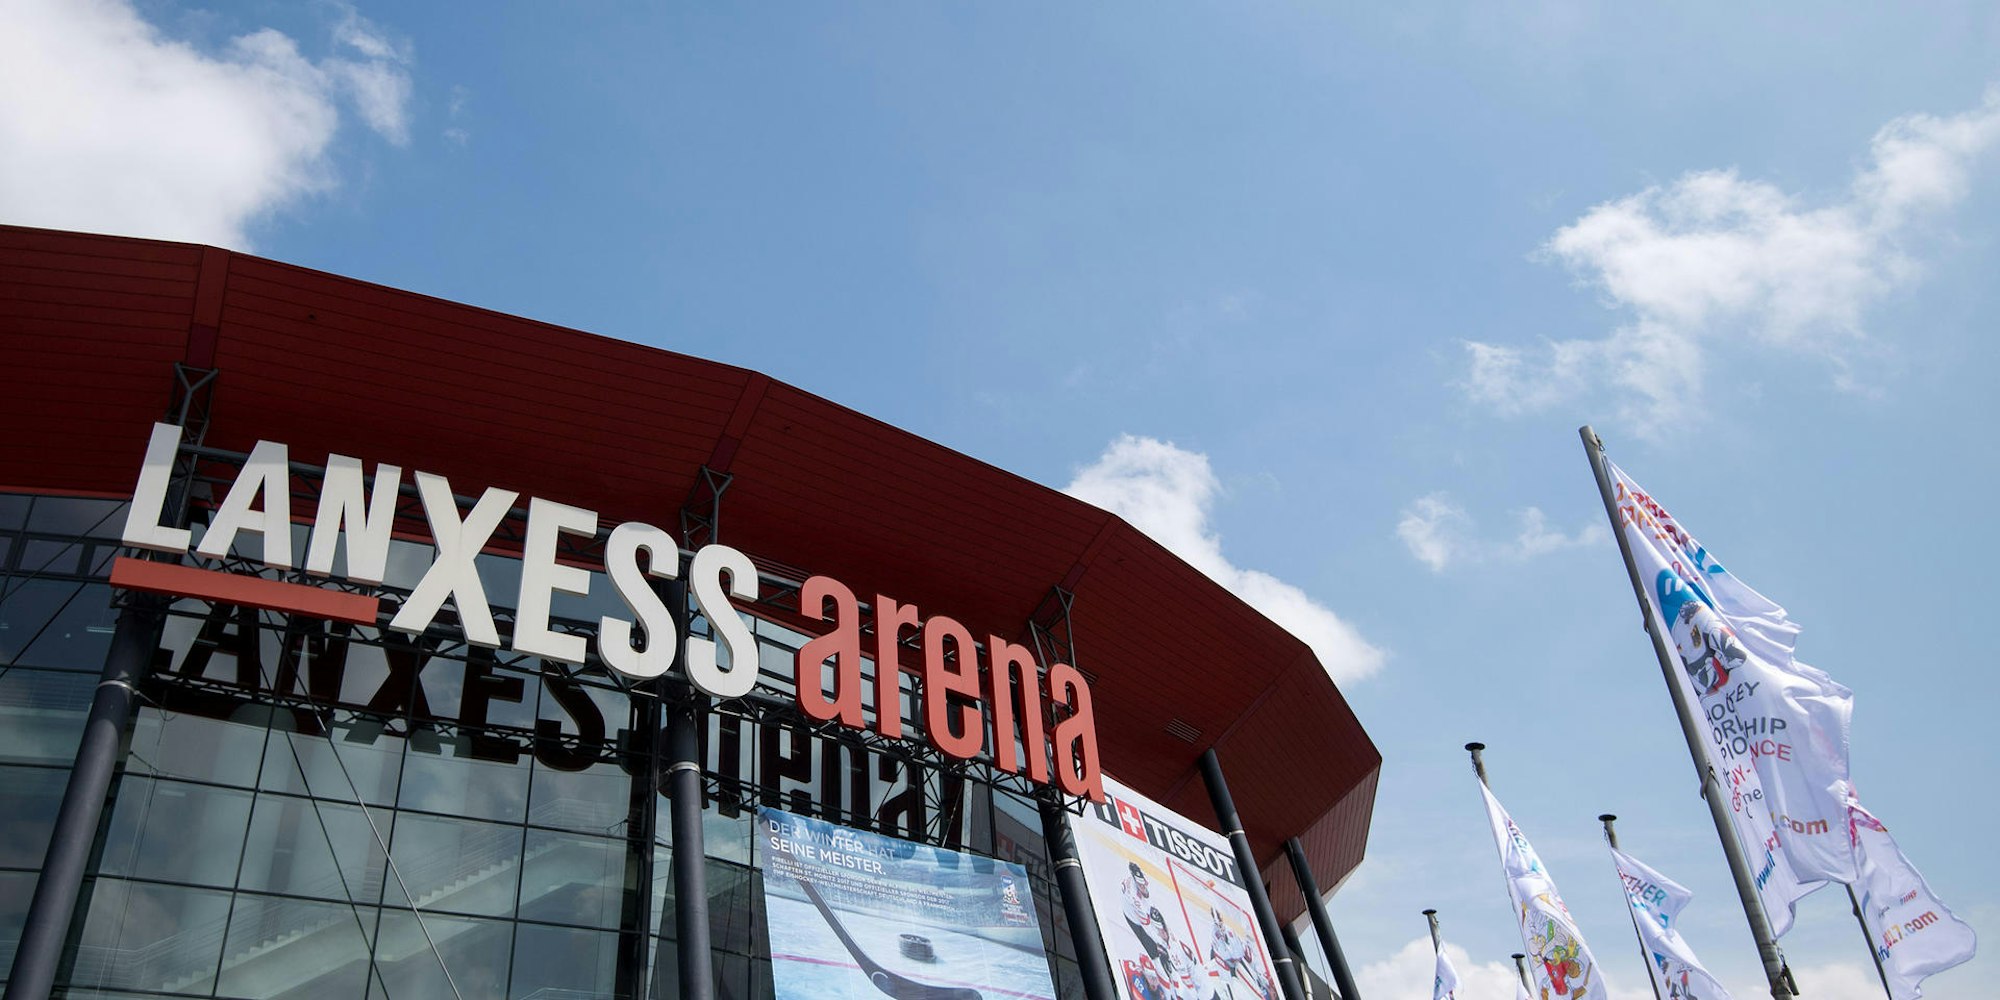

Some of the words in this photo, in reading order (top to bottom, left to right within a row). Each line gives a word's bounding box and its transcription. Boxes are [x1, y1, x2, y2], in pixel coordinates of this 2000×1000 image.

[122, 421, 759, 698] LANXESS
[796, 575, 1106, 805] arena
[1744, 716, 1787, 738] HIP
[1749, 739, 1792, 762] NCE
[769, 819, 801, 839] DER
[802, 829, 865, 853] WINTER
[868, 845, 896, 861] HAT
[770, 836, 816, 859] SEINE
[819, 848, 887, 875] MEISTER.
[1143, 818, 1235, 883] TISSOT
